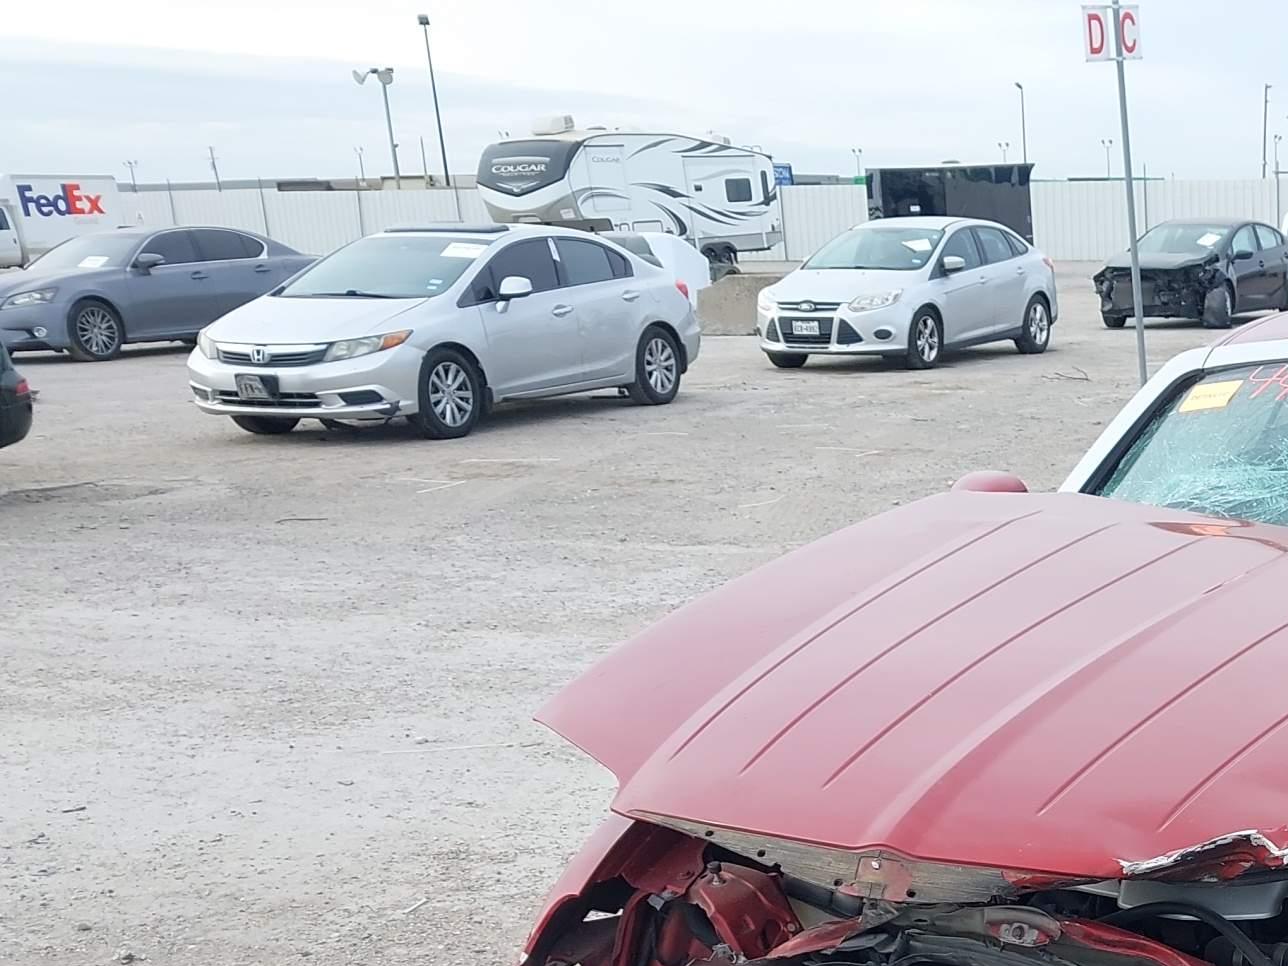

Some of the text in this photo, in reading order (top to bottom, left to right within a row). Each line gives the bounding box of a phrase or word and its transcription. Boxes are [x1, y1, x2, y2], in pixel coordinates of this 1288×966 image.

[1087, 13, 1105, 54] D
[1120, 11, 1137, 54] C
[491, 163, 547, 174] COUGAR
[16, 183, 106, 217] FedEx
